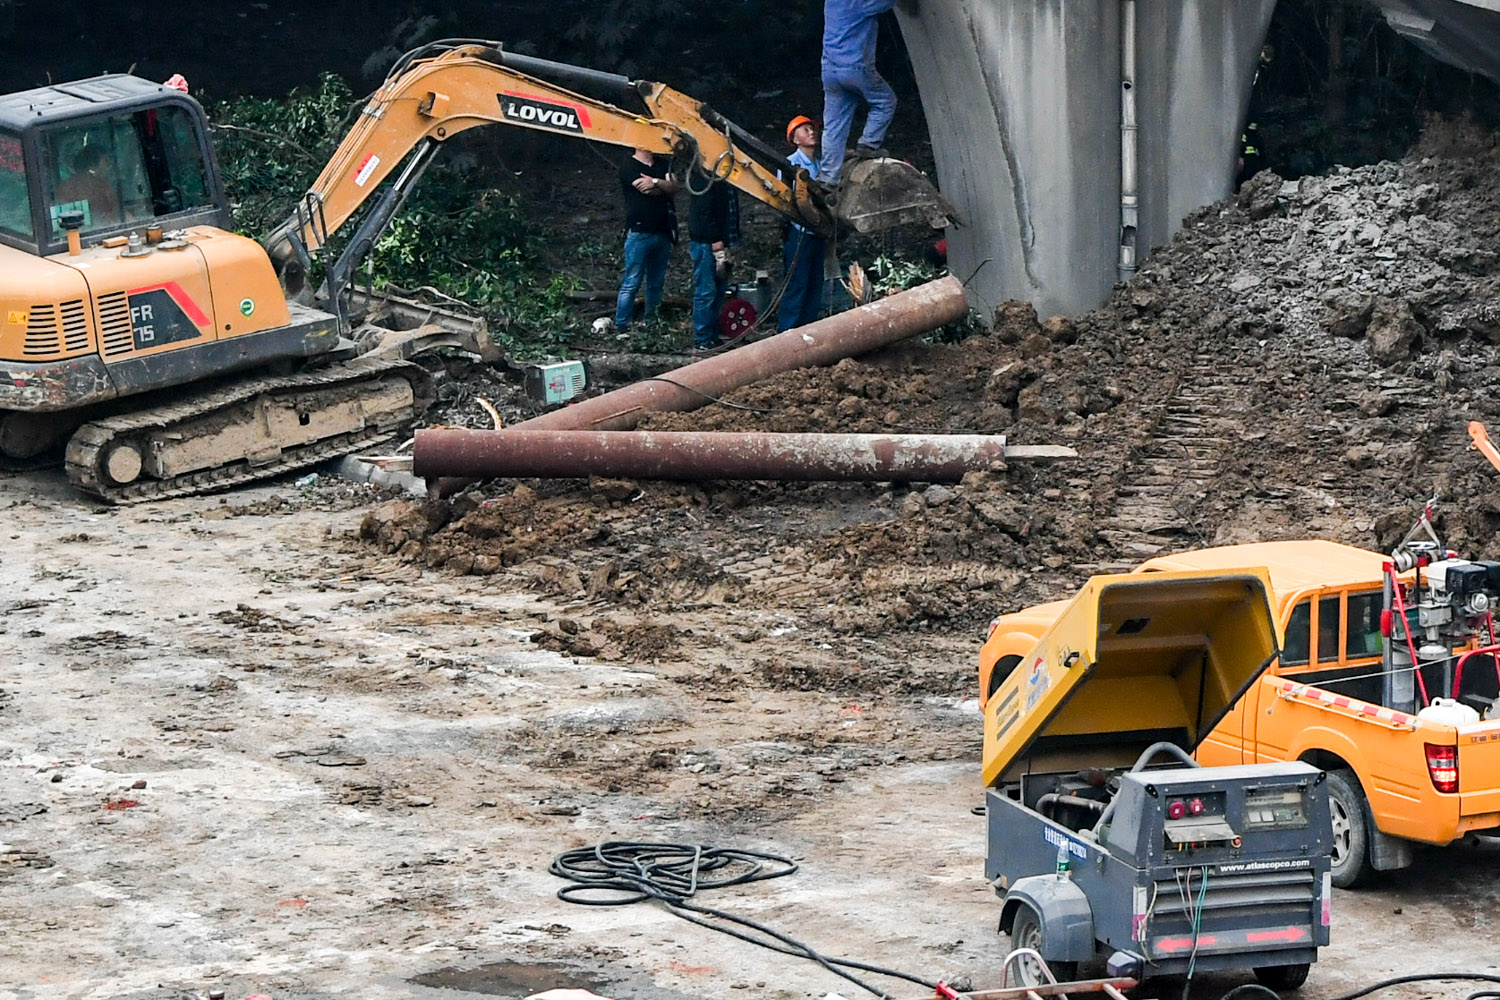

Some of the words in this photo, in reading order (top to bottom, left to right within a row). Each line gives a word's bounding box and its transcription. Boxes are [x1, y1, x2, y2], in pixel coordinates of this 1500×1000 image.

[507, 102, 579, 129] LOVOL
[130, 304, 154, 324] FR
[1220, 859, 1310, 873] www.atlascopco.com
